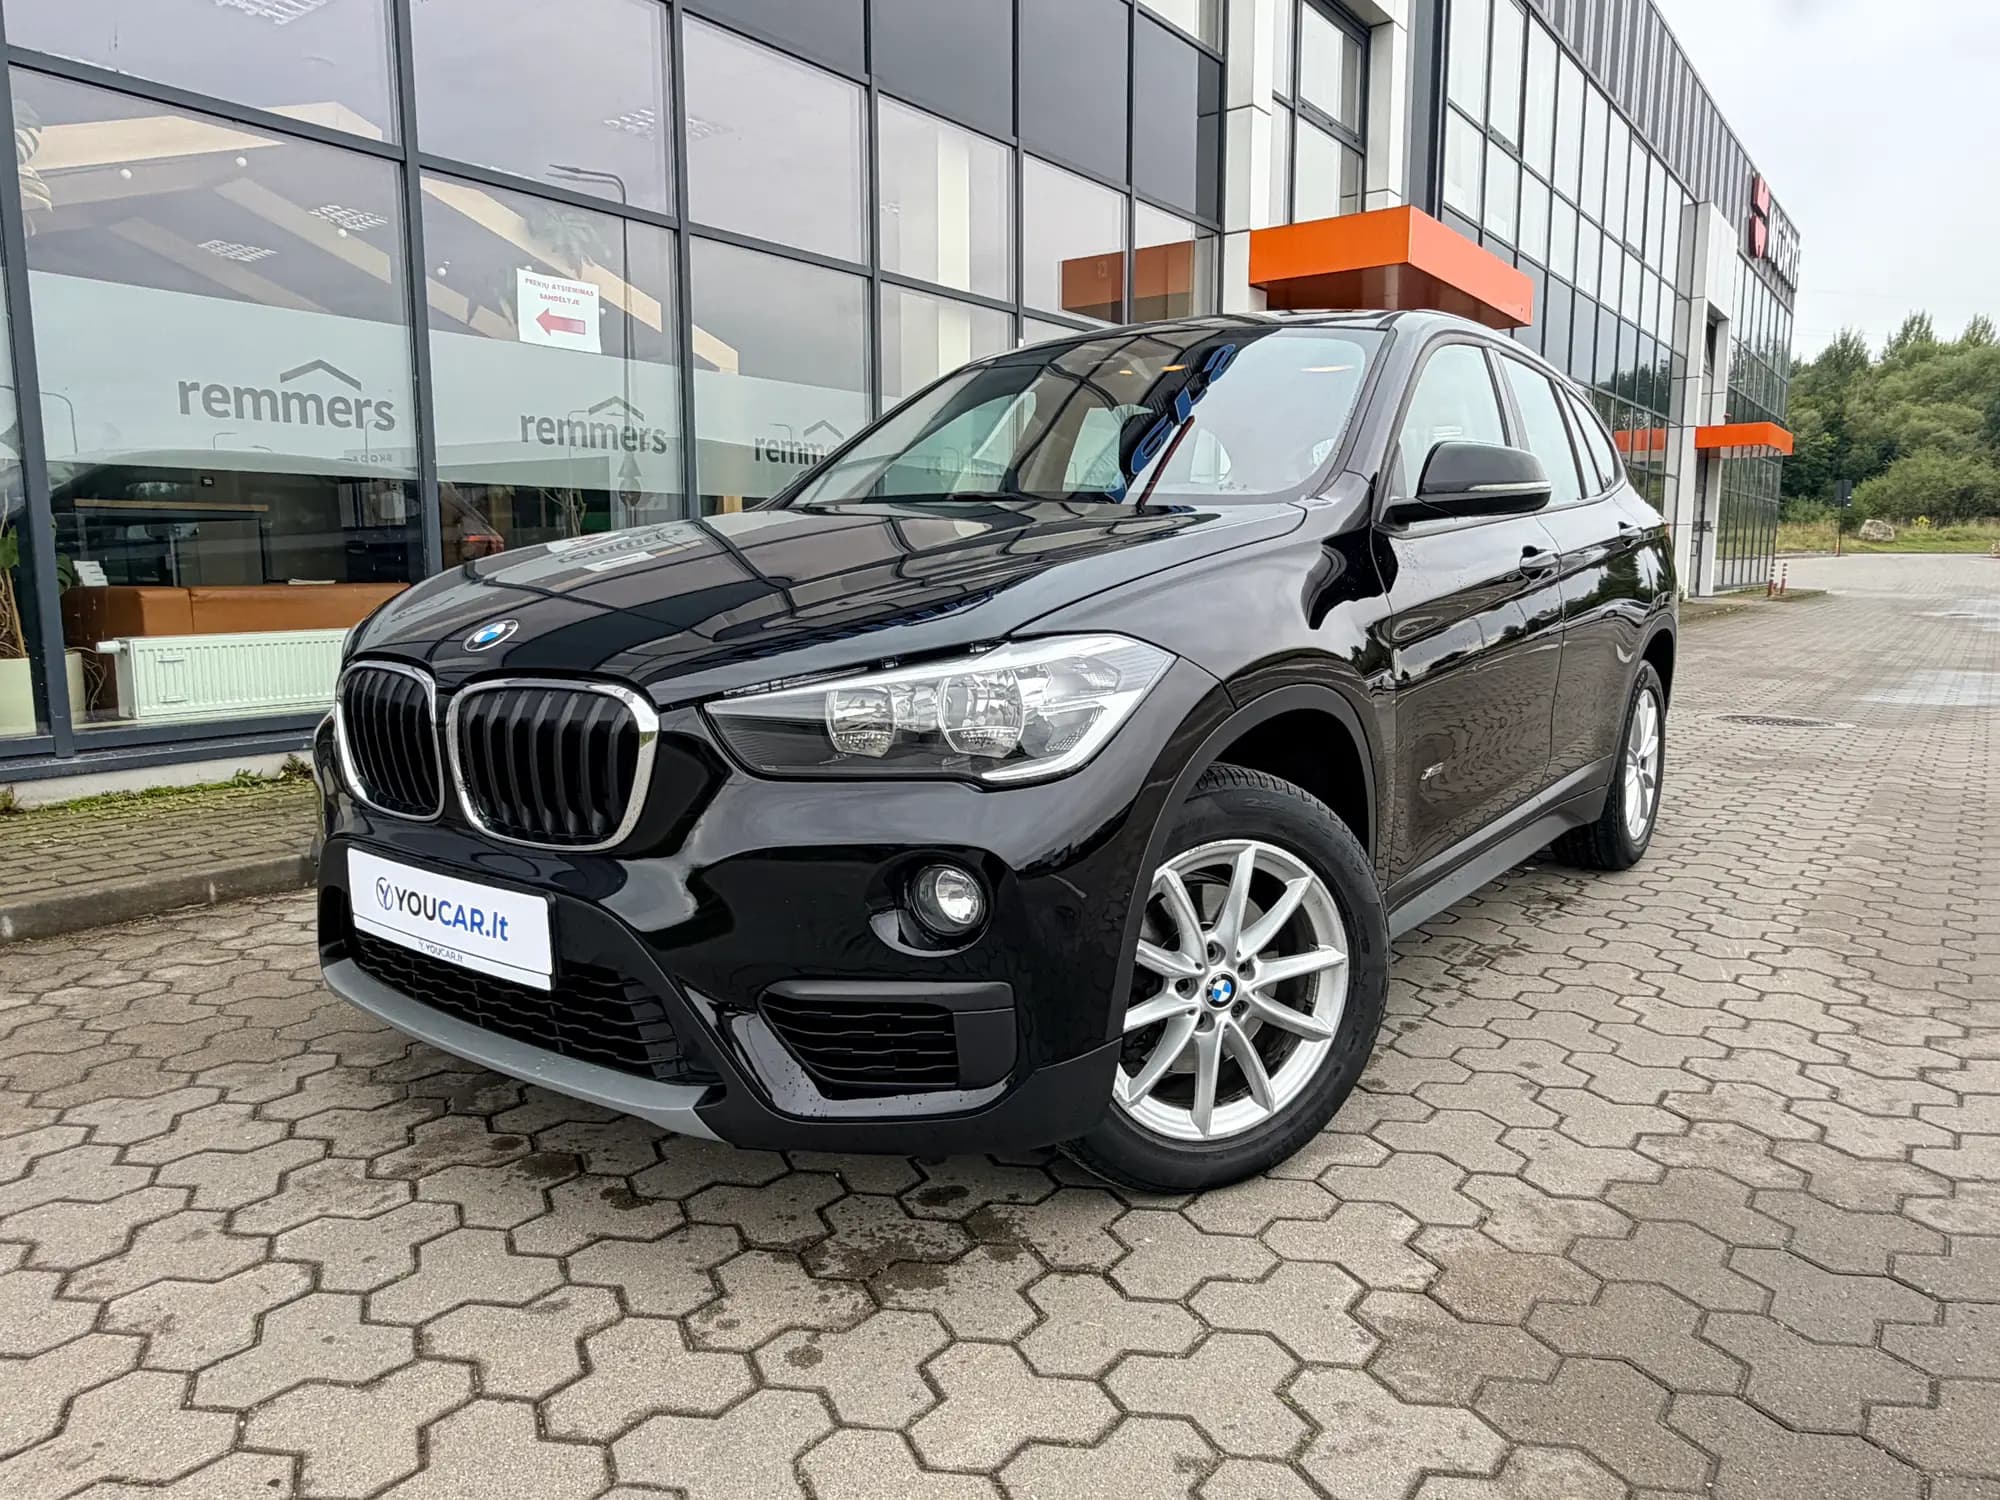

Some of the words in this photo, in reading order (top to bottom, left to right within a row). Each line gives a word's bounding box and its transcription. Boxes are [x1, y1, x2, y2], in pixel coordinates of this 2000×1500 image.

[178, 380, 396, 432] remmers
[520, 415, 668, 455] remmers
[394, 886, 509, 942] YOUCAR.lt
